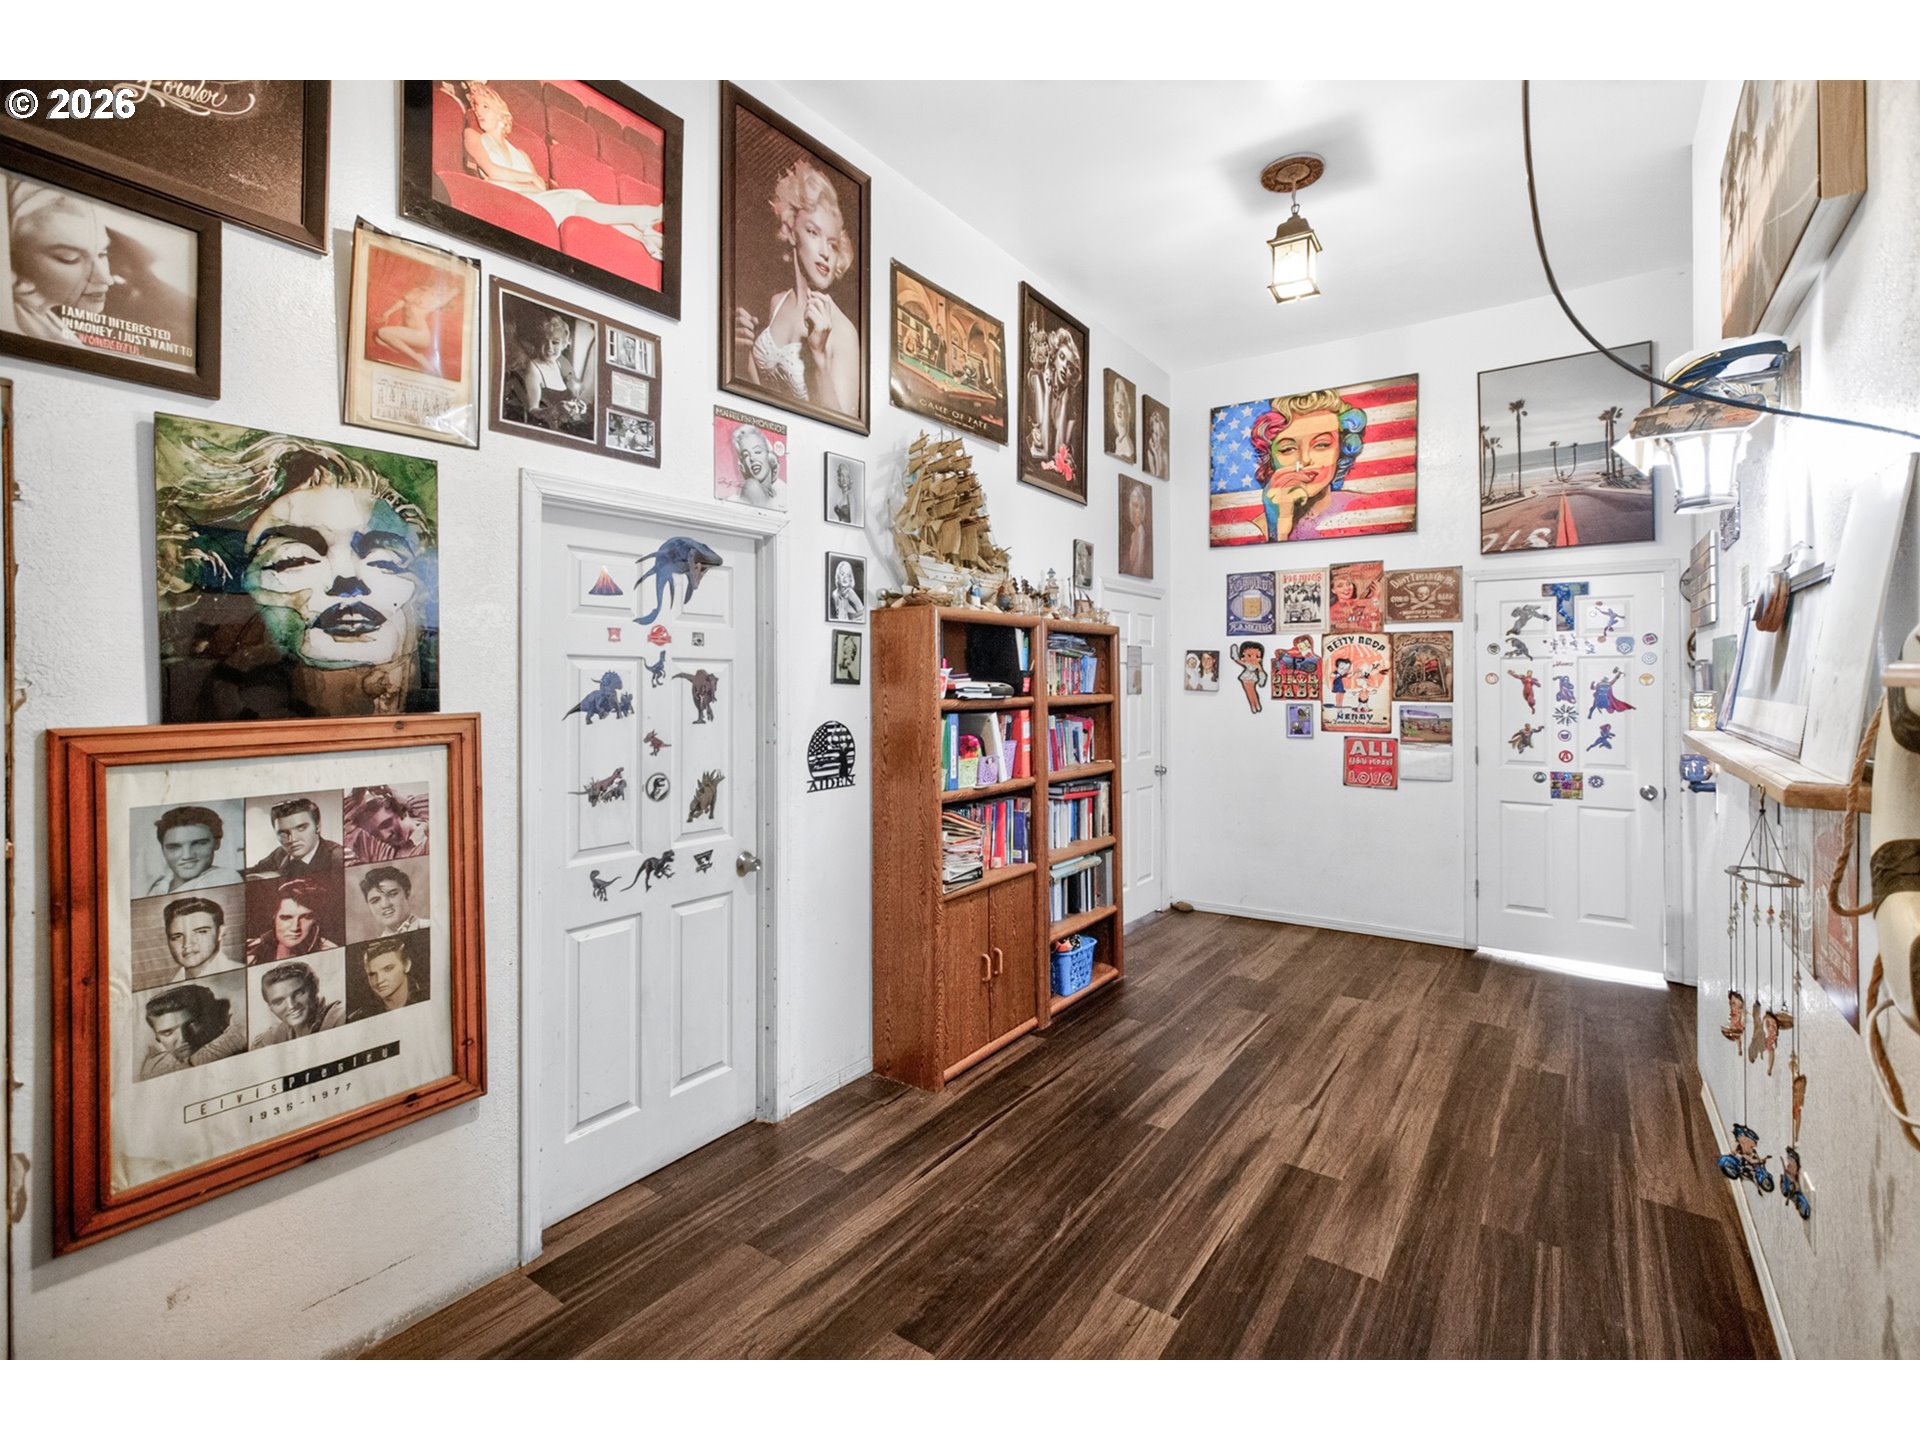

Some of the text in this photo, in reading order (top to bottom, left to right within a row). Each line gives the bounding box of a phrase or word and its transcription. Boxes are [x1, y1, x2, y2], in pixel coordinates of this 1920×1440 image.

[61, 304, 171, 340] I AM NOT INTERESTED
[124, 332, 148, 346] JUST
[149, 336, 180, 355] WANT
[181, 345, 193, 358] TO
[1326, 636, 1355, 652] BETTY
[1358, 636, 1386, 652] BOOP
[1349, 740, 1393, 757] ALL
[807, 774, 855, 793] AIDEN
[249, 1082, 352, 1123] 1935-1977
